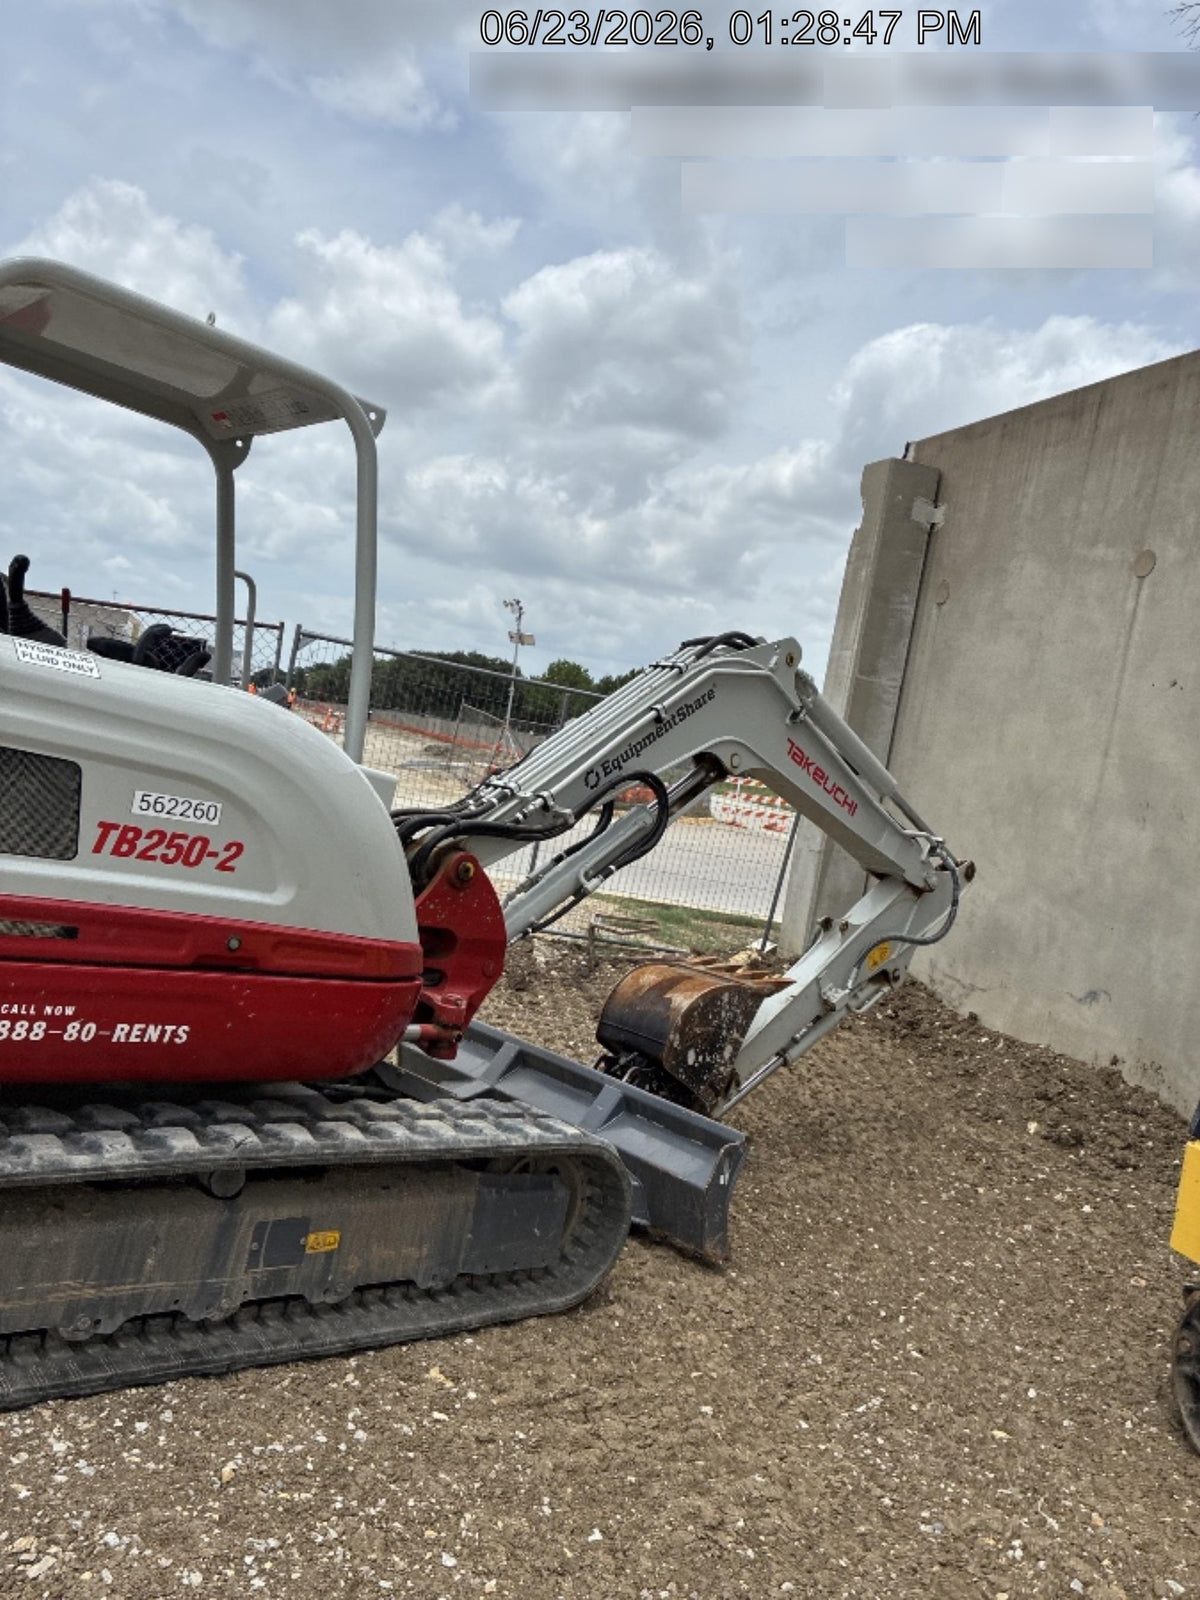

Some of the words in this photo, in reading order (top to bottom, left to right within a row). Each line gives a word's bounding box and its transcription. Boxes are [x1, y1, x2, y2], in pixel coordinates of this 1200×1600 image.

[22, 650, 59, 665] FLUID
[62, 660, 95, 673] ONLY
[600, 688, 716, 777] EquipmentShare
[139, 793, 218, 822] 562260
[92, 821, 244, 872] TB250-2
[1, 1004, 36, 1015] CALL
[44, 1005, 76, 1016] NOW
